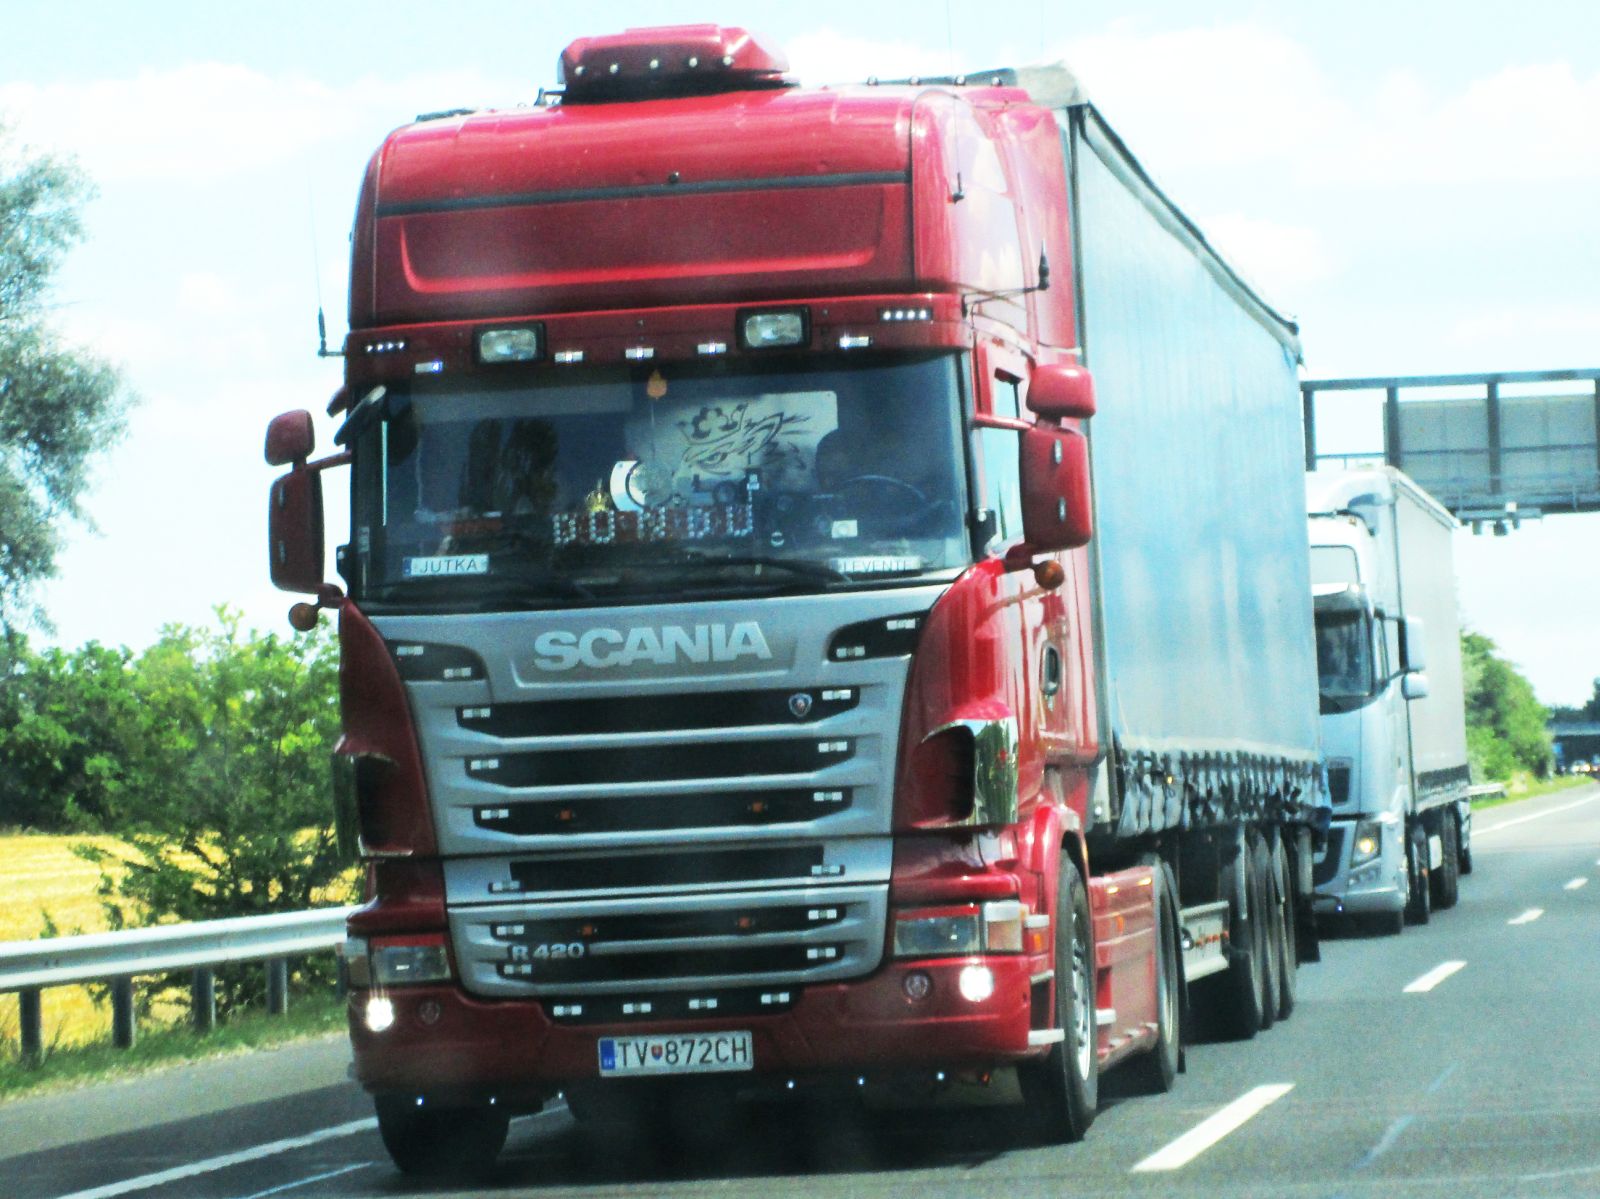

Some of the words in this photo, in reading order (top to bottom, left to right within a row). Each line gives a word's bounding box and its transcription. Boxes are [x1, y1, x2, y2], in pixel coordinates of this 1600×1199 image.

[424, 558, 478, 573] JUTKA
[534, 621, 772, 671] SCANIA
[512, 945, 529, 960] R
[533, 942, 584, 959] 420
